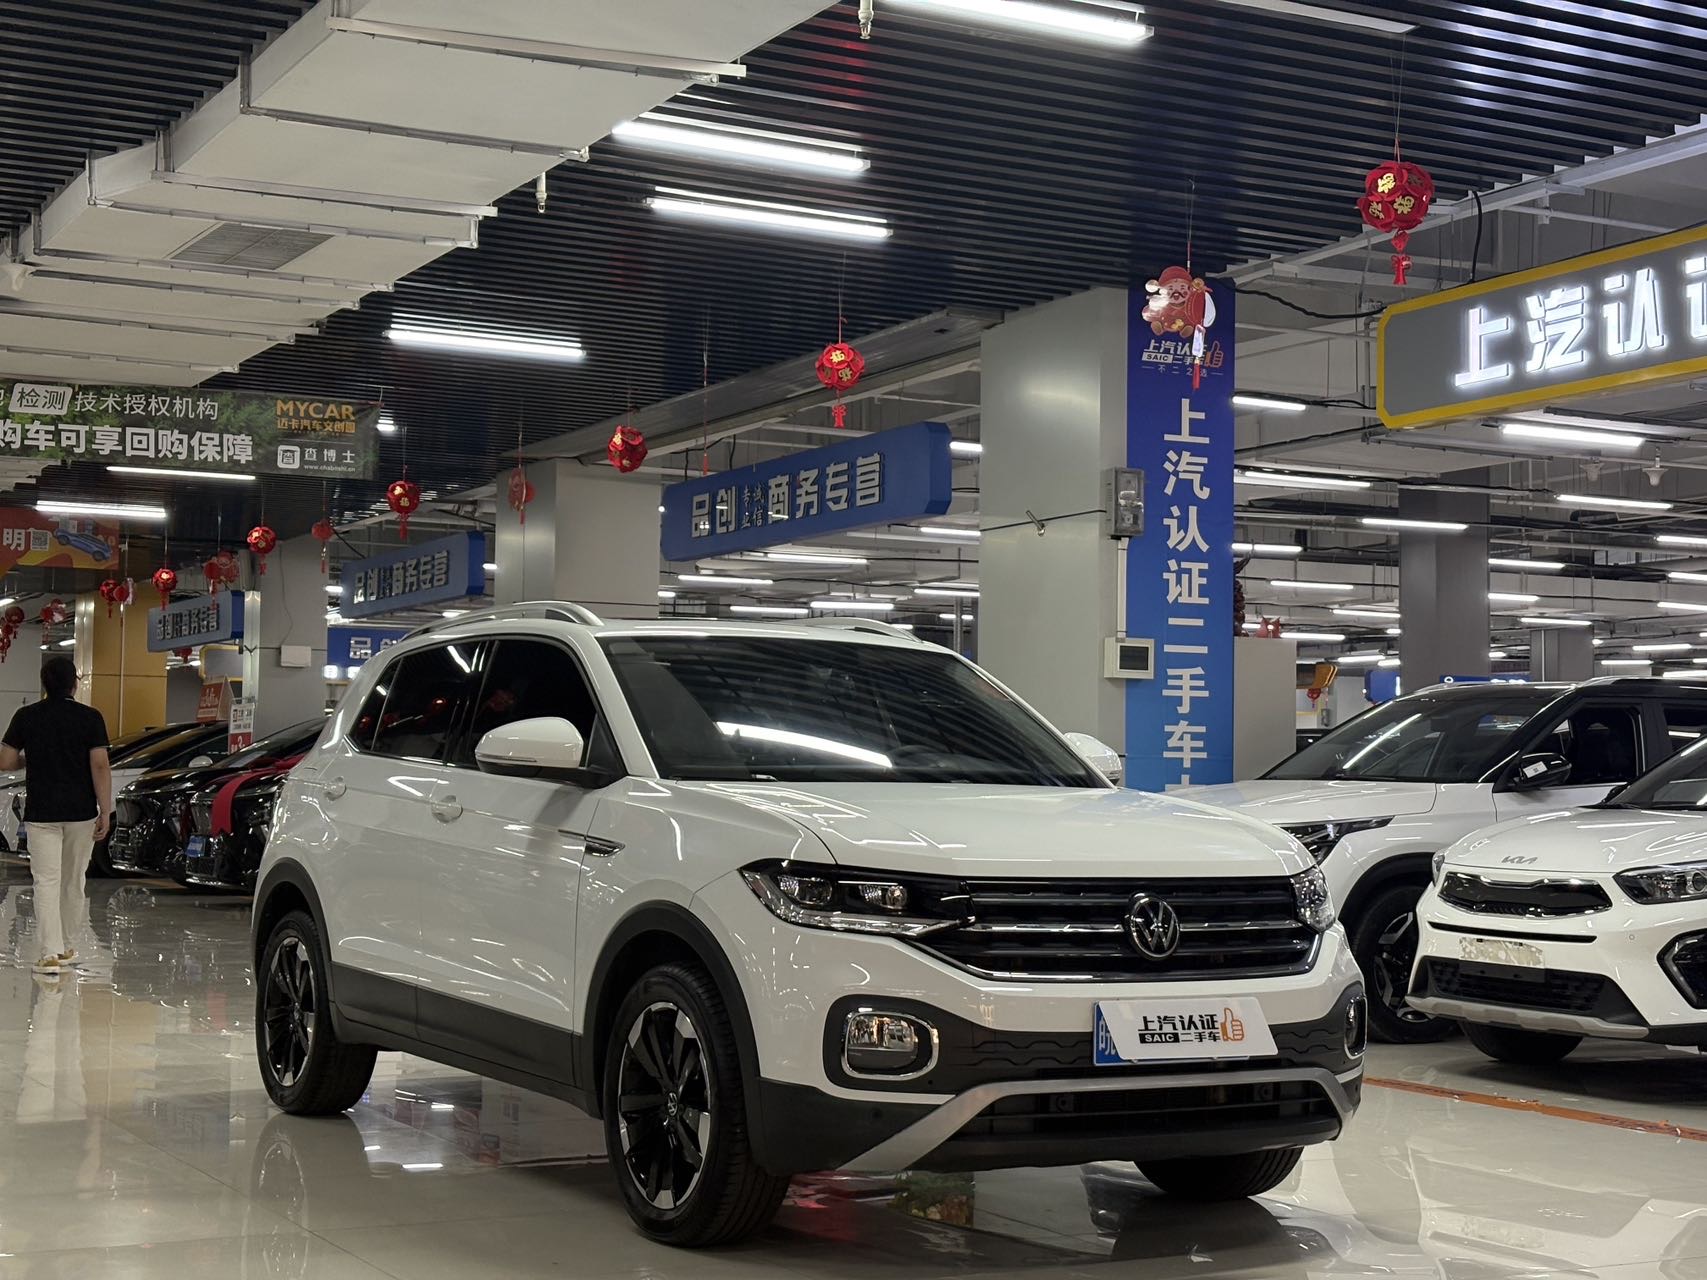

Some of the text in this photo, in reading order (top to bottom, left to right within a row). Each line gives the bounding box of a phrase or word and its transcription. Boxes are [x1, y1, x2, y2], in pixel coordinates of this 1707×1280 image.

[16, 387, 66, 411] 检测
[74, 391, 219, 421] 技术授权机构
[276, 399, 356, 421] MYCAR
[0, 418, 254, 465] 购车可享回购保障
[303, 447, 356, 464] 查博士
[691, 485, 737, 538] 品创
[768, 452, 882, 525] 商务专营
[392, 549, 449, 596] 商务专营
[1137, 1013, 1220, 1032] 上汽认证
[1144, 1031, 1221, 1043] SAIC 二手车
